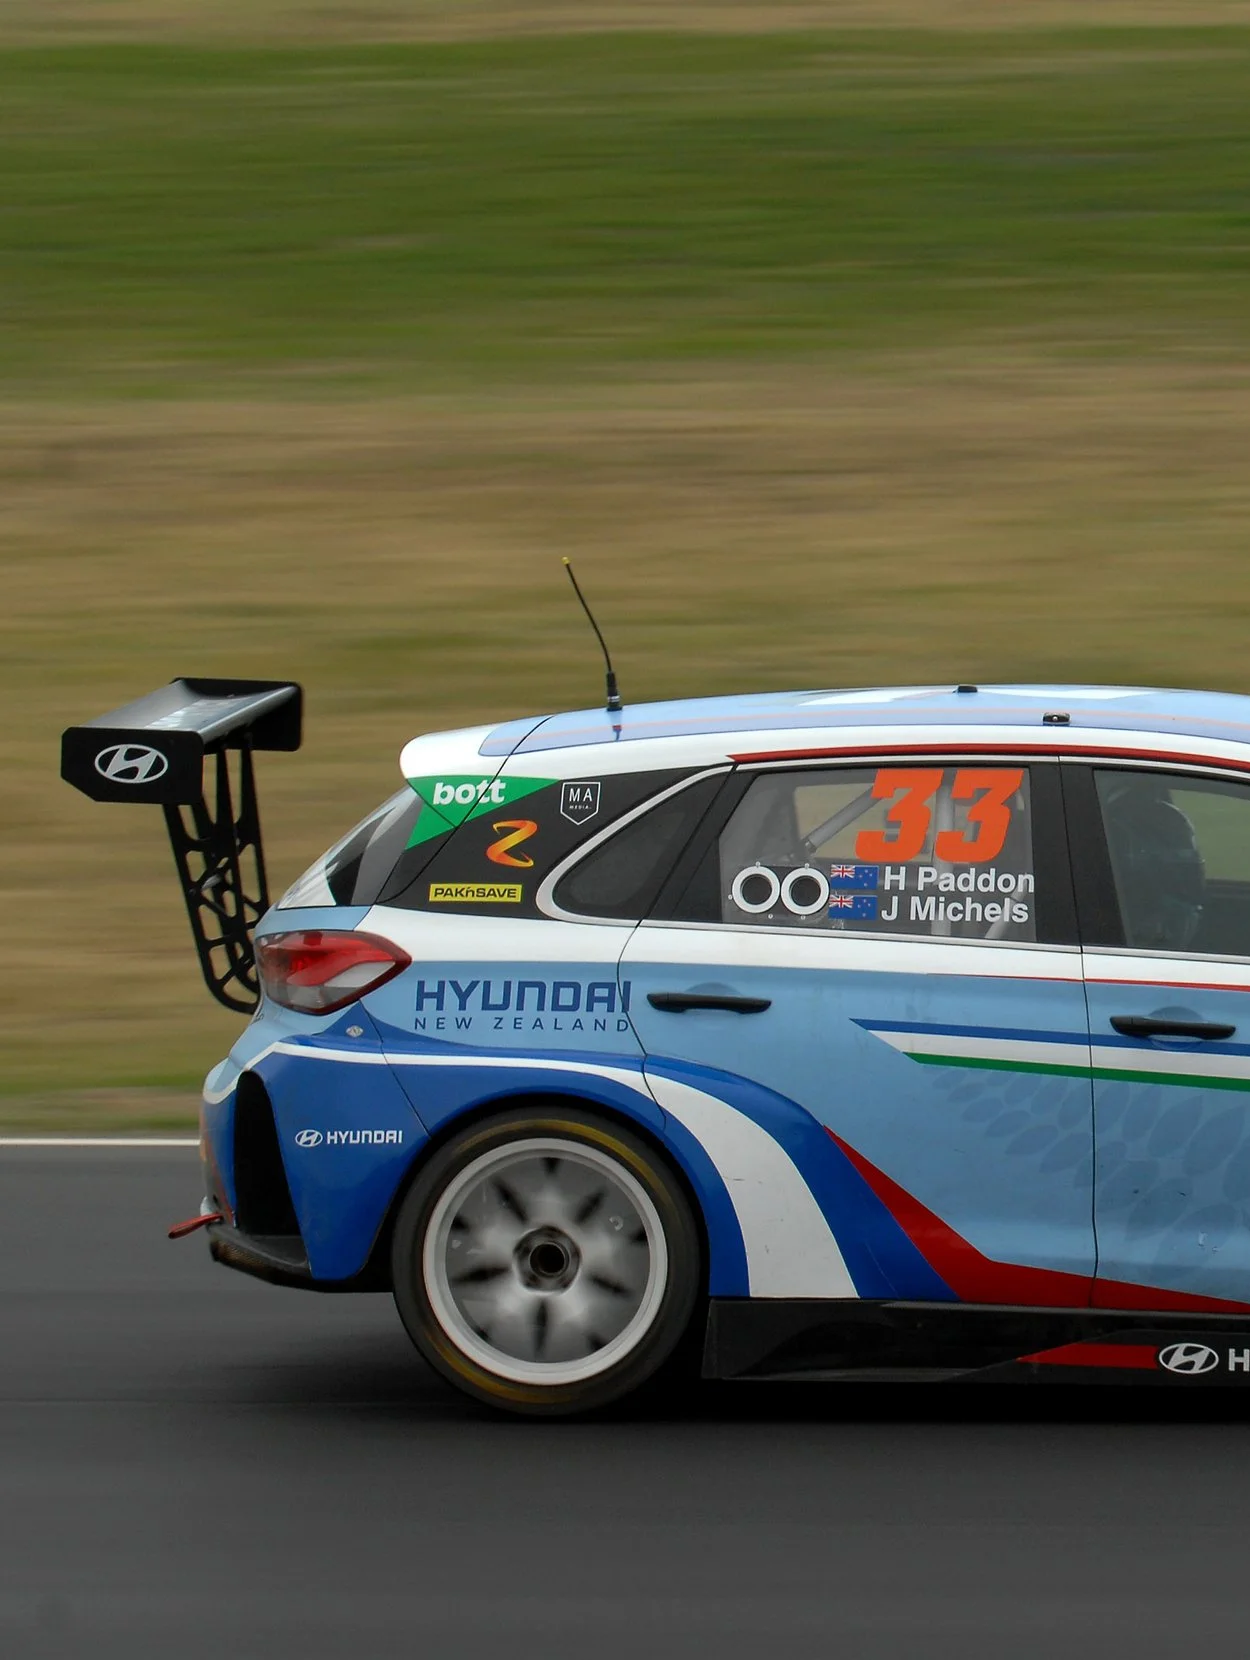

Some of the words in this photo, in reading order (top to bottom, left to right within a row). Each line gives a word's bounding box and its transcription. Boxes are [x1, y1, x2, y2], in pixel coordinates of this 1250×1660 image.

[432, 779, 506, 806] bott
[854, 768, 1024, 863] 33
[883, 866, 906, 891] H
[917, 867, 1035, 893] Paddon
[881, 896, 899, 922] J
[910, 896, 1029, 923] Michels
[415, 980, 631, 1012] HYUNDAI
[414, 1017, 472, 1030] NEW
[493, 1017, 630, 1033] ZEALAND
[327, 1130, 402, 1144] HYUNDAI
